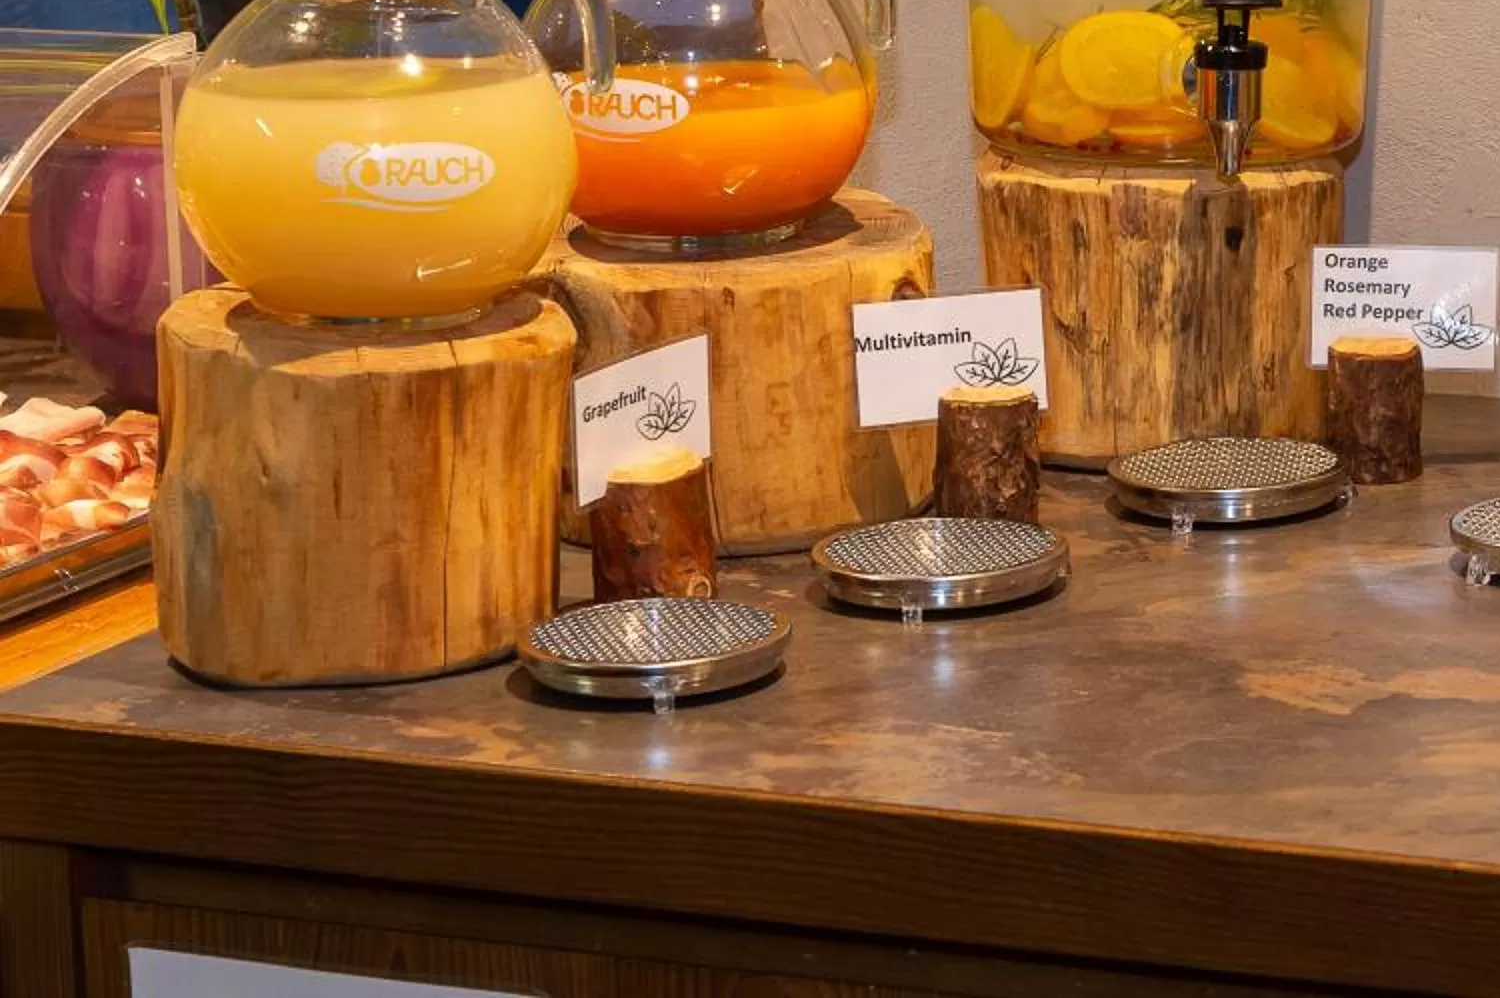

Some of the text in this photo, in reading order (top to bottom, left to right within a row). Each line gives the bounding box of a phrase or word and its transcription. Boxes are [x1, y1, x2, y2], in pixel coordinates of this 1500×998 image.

[588, 93, 678, 121] RAUCH
[384, 155, 485, 187] RAUCH
[1324, 253, 1389, 273] Orange
[1323, 278, 1411, 299] Rosemary
[1323, 303, 1424, 323] Red Pepper
[855, 327, 972, 353] Multivitamin
[582, 385, 648, 423] Grapefruit
